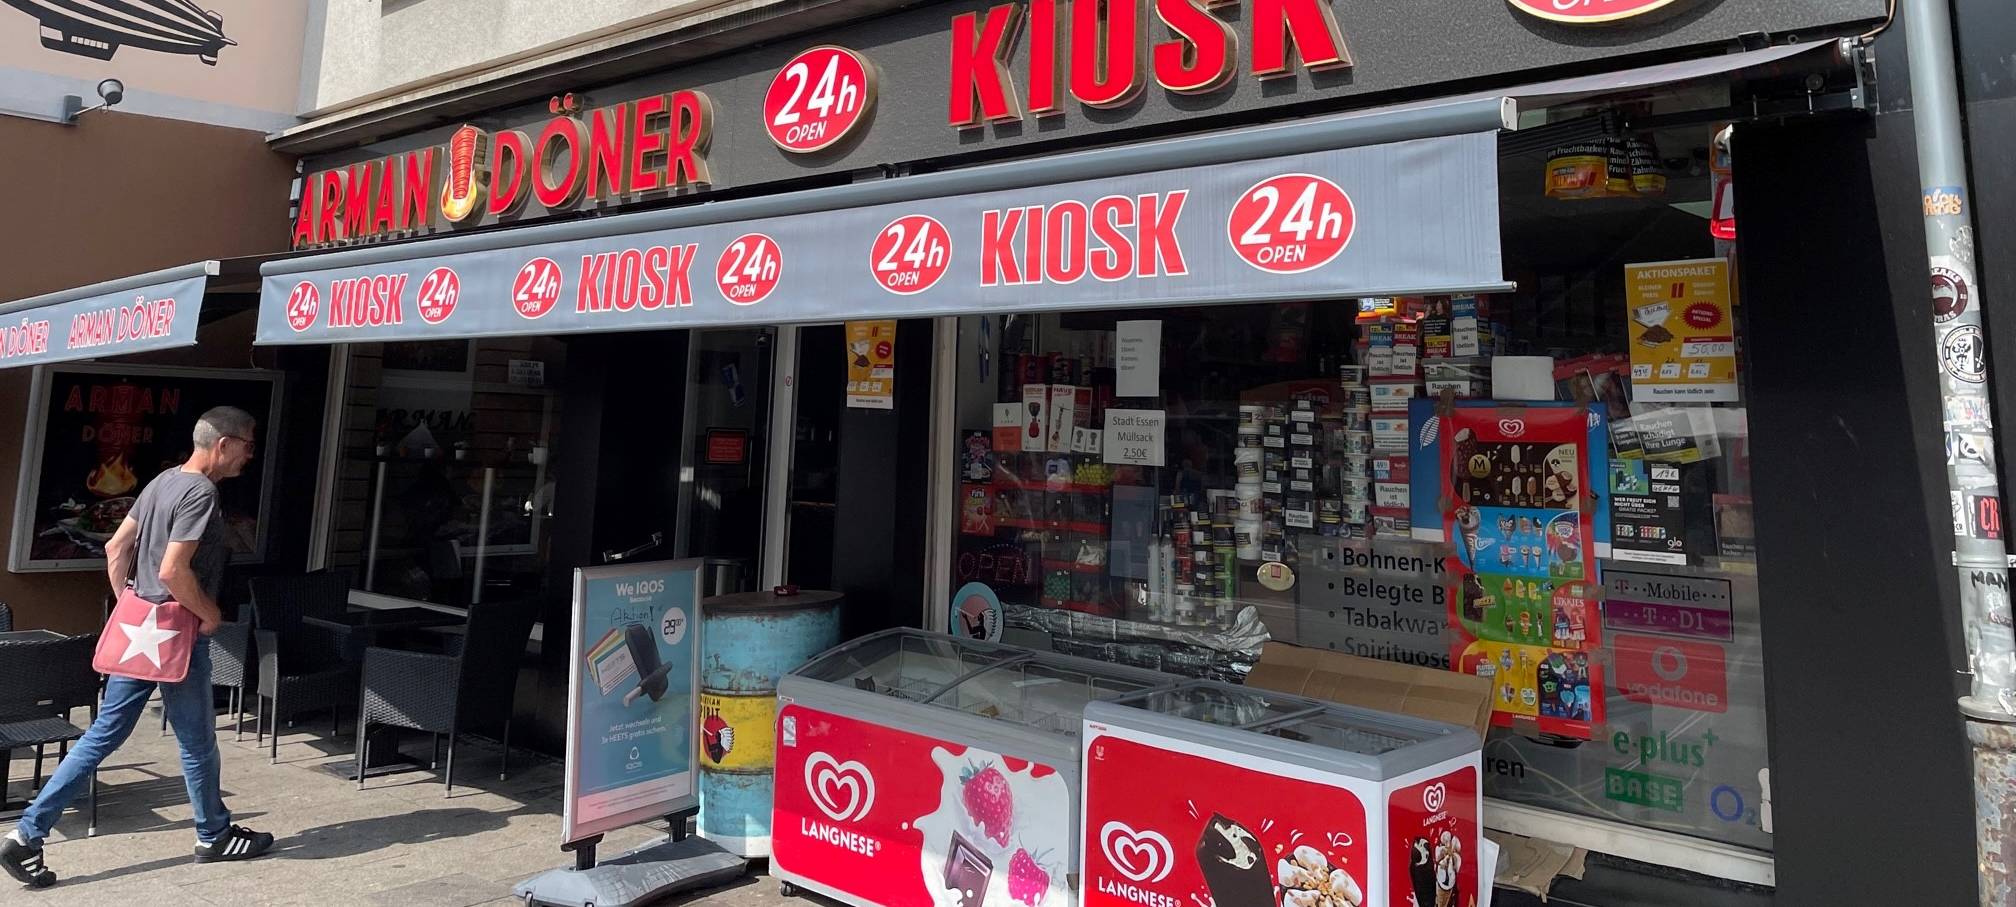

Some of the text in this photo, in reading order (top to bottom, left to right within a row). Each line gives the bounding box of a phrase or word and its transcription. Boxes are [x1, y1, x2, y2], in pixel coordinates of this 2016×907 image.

[947, 0, 1345, 127] KIOSK
[773, 54, 859, 127] 24h
[785, 122, 827, 144] OPEN
[293, 91, 712, 246] ARMAN DÖNER
[1239, 186, 1344, 246] 24h
[878, 224, 945, 273] 24h
[979, 188, 1189, 288] KIOSK
[721, 241, 776, 283] 24h
[1257, 243, 1307, 265] OPEN
[516, 263, 558, 301] 24h
[576, 243, 699, 314] KIOSK
[887, 270, 920, 288] OPEN
[1637, 265, 1717, 280] AKTIONSPAKET
[289, 286, 318, 319] 24h
[327, 273, 408, 329] KIOSK
[420, 272, 457, 309] 24h
[730, 283, 757, 299] OPEN
[425, 307, 443, 319] OPEN
[521, 301, 543, 313] OPEN
[67, 296, 176, 350] ARMAN DÖNER
[292, 316, 307, 328] OPEN
[8, 317, 50, 359] DÖNER
[1431, 383, 1461, 391] Rauchen
[1112, 415, 1160, 427] Stadt Essen
[1117, 430, 1154, 442] Müllsack
[1558, 448, 1575, 456] NEU
[1667, 536, 1683, 549] glo
[615, 579, 665, 597] We IQOS
[1343, 577, 1424, 606] Belegte
[1647, 583, 1701, 601] Mobile
[1679, 611, 1704, 630] D1
[1626, 681, 1718, 706] vodafone
[1609, 774, 1678, 806] BASE
